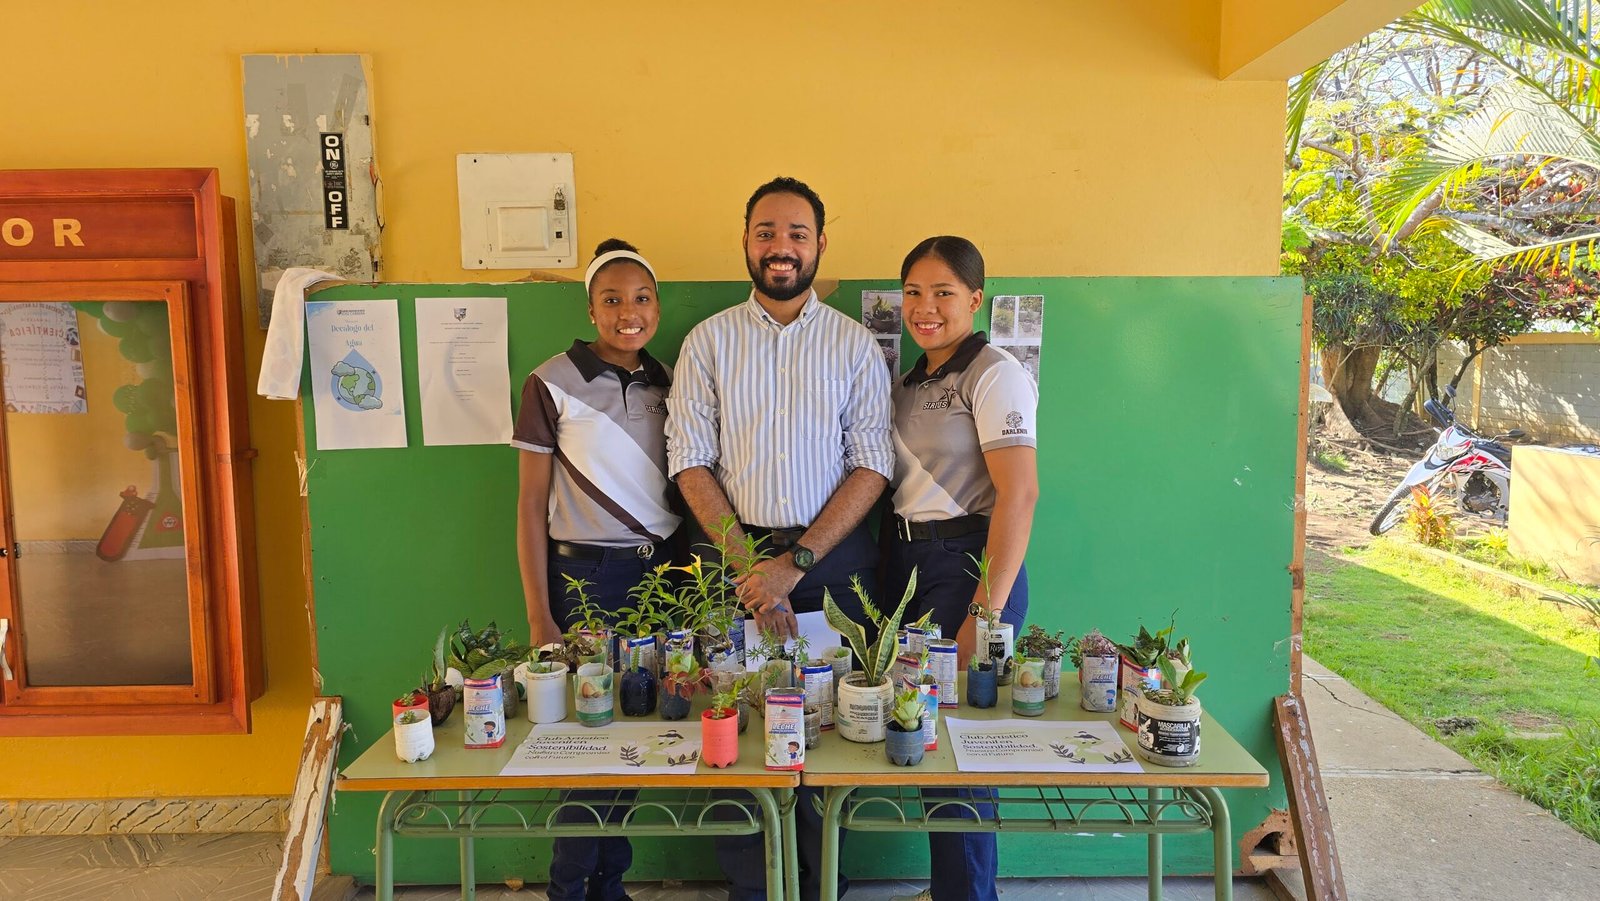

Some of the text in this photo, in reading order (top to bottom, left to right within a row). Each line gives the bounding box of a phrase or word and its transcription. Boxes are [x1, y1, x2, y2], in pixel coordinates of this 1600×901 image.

[325, 135, 340, 161] ON
[328, 190, 343, 229] OFF
[363, 323, 374, 331] del
[923, 401, 948, 410] SIRIUS
[1158, 721, 1191, 729] MASCARILLA
